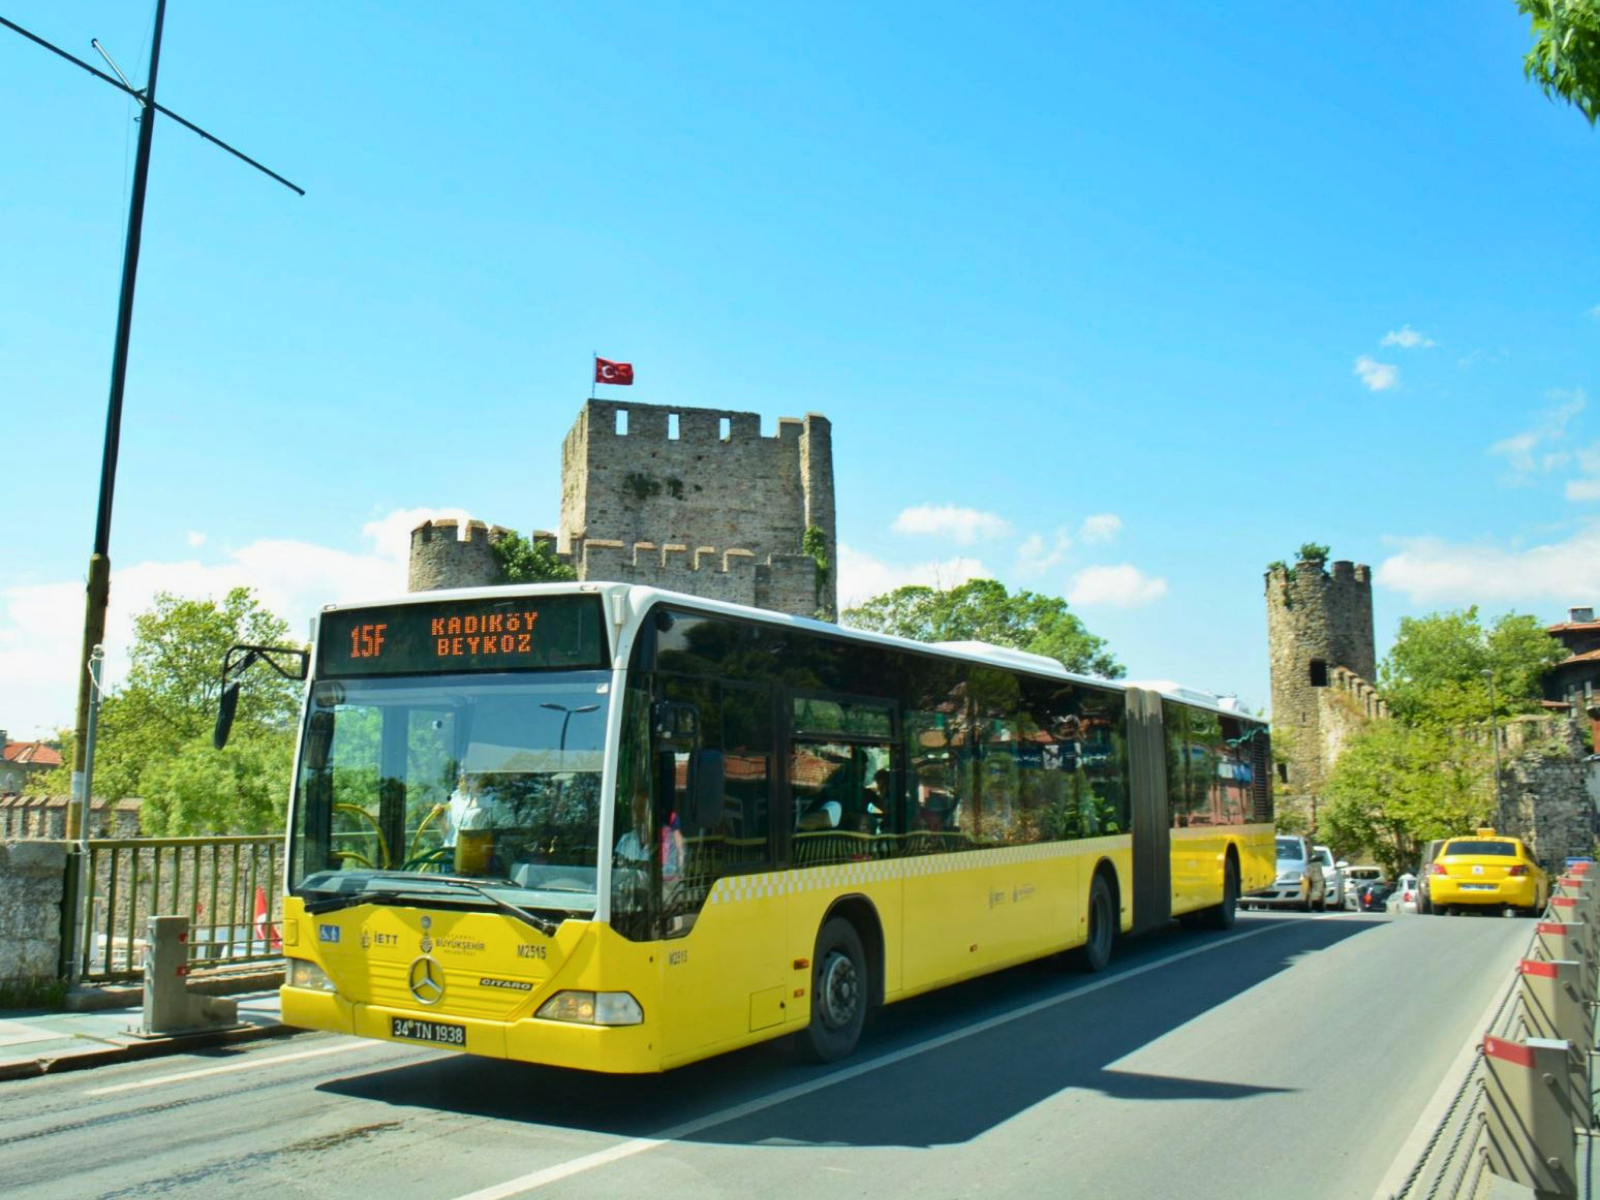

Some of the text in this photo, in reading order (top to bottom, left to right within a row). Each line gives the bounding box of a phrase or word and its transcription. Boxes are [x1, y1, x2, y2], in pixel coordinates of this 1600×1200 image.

[351, 624, 387, 658] 15F
[438, 634, 530, 656] BEYKOZ
[517, 945, 547, 960] M2515
[481, 978, 531, 990] CITARO
[394, 1019, 463, 1043] 34 TN 1938
